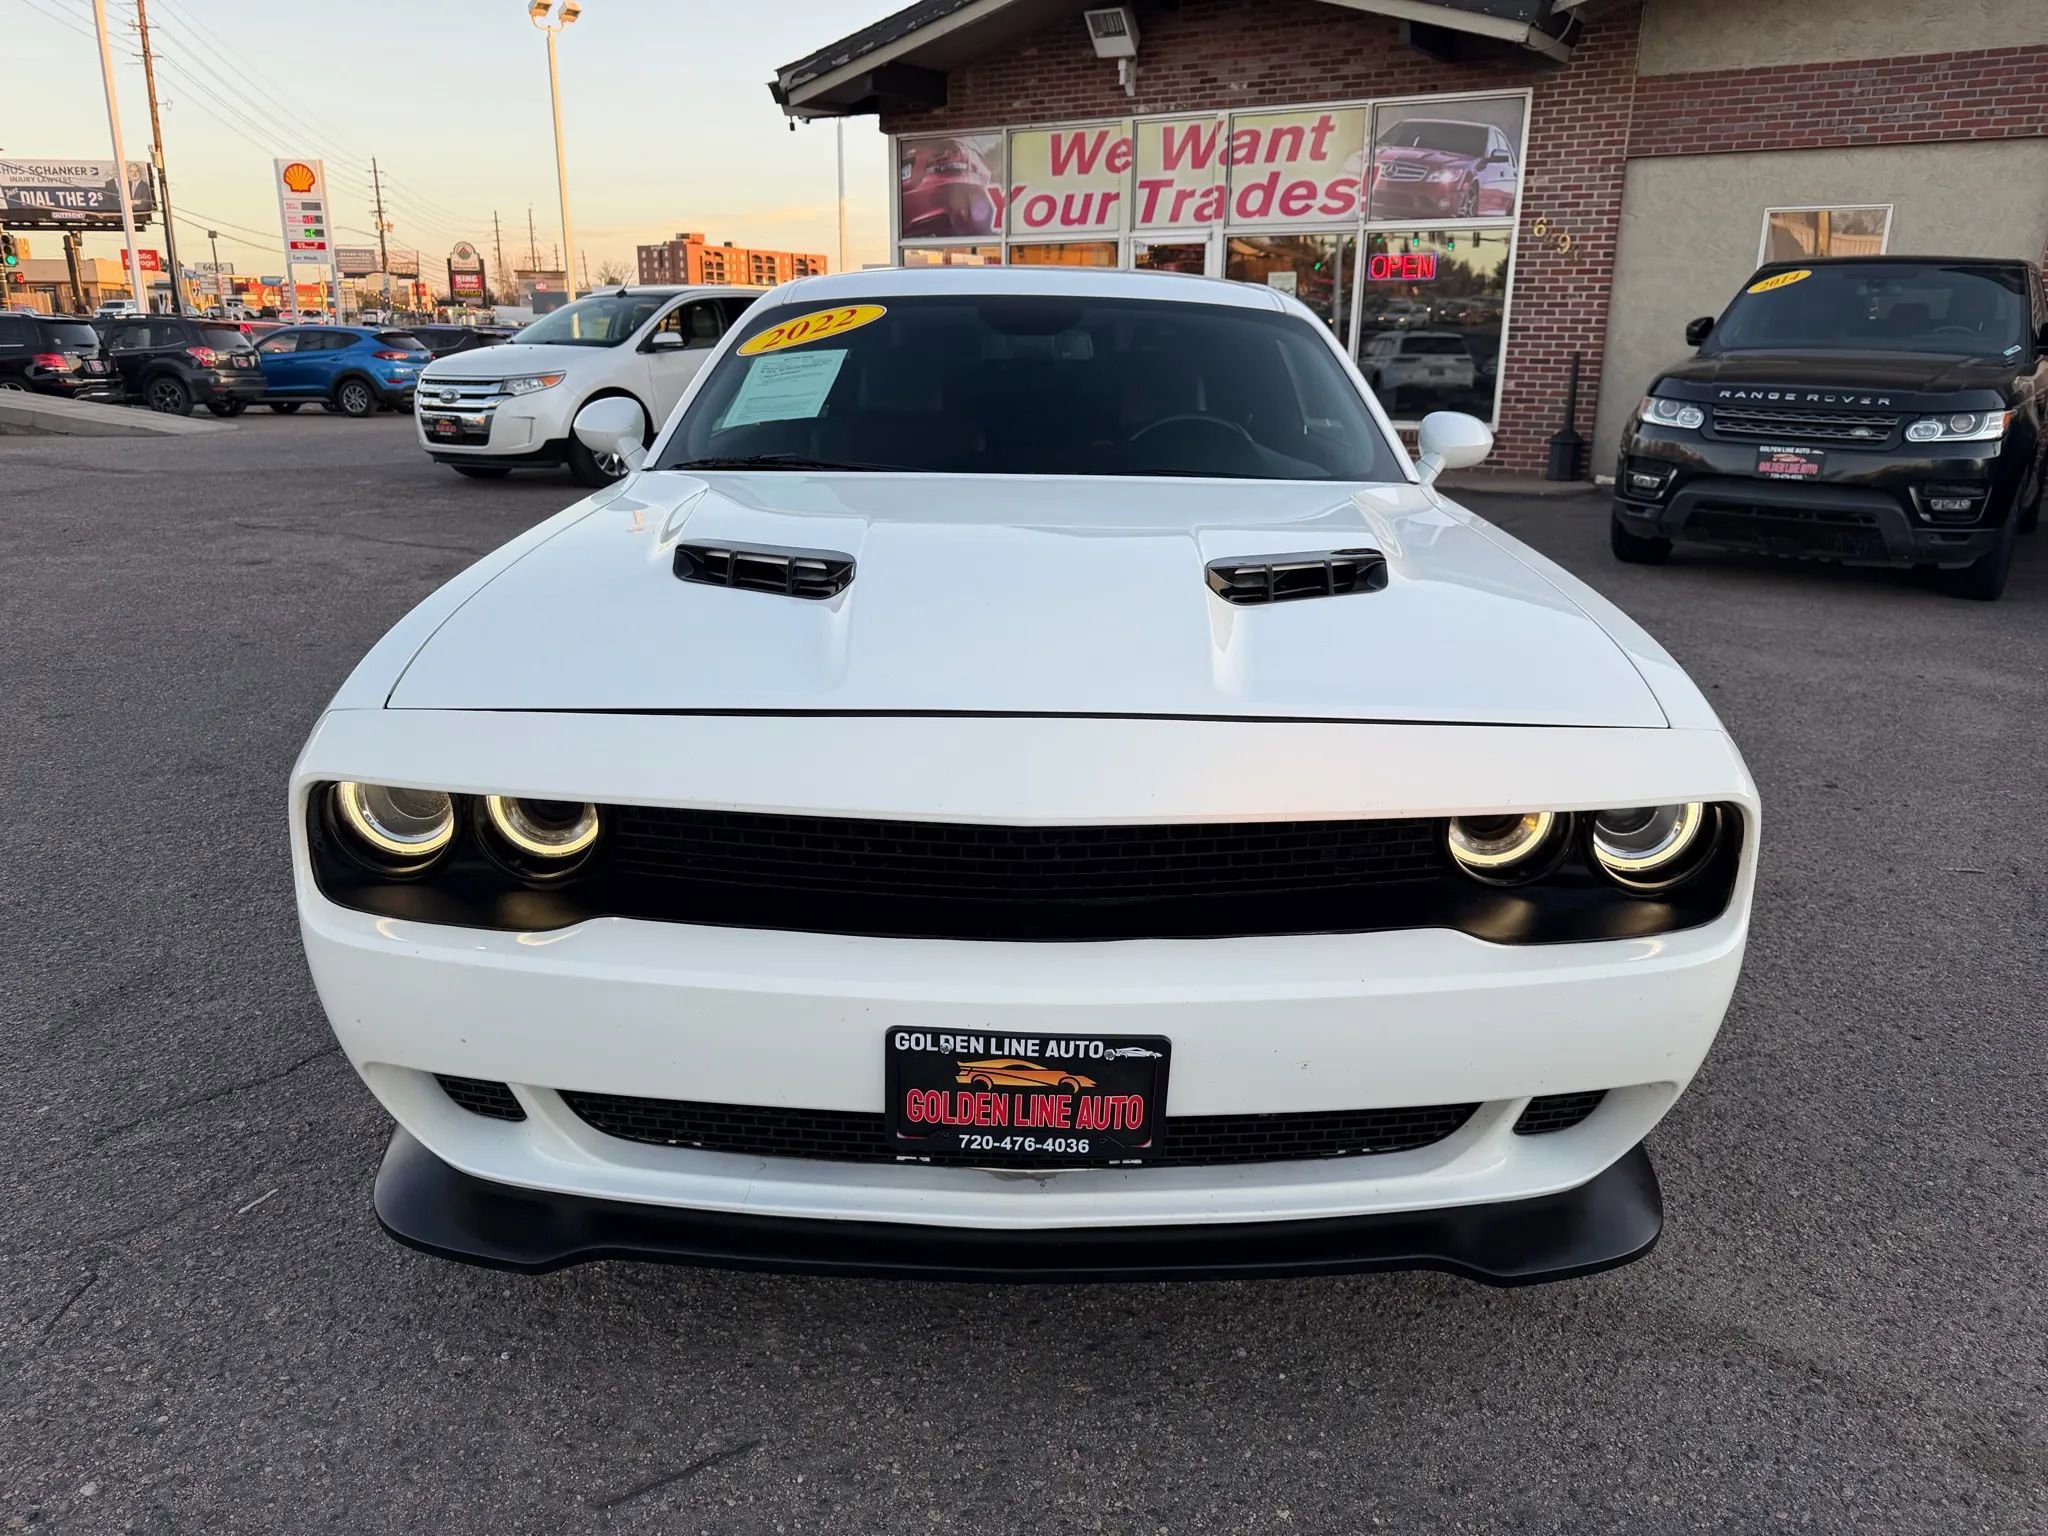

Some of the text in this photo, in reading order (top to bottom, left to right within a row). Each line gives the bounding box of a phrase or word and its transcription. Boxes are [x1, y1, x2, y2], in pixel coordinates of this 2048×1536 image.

[1051, 115, 1336, 176] We Want
[0, 165, 88, 176] HUS SCHANKER
[20, 190, 55, 206] DIAL
[56, 191, 86, 206] THE
[987, 165, 1380, 229] Your Trades!
[1370, 255, 1435, 279] OPEN
[761, 308, 857, 349] 2022
[1719, 390, 1891, 406] RANGE ROVER
[894, 1032, 1104, 1060] GOLDEN LINE AUTO
[906, 1088, 1144, 1131] GOLDEN LINE AUTO
[958, 1134, 1090, 1154] 720-476-4036
